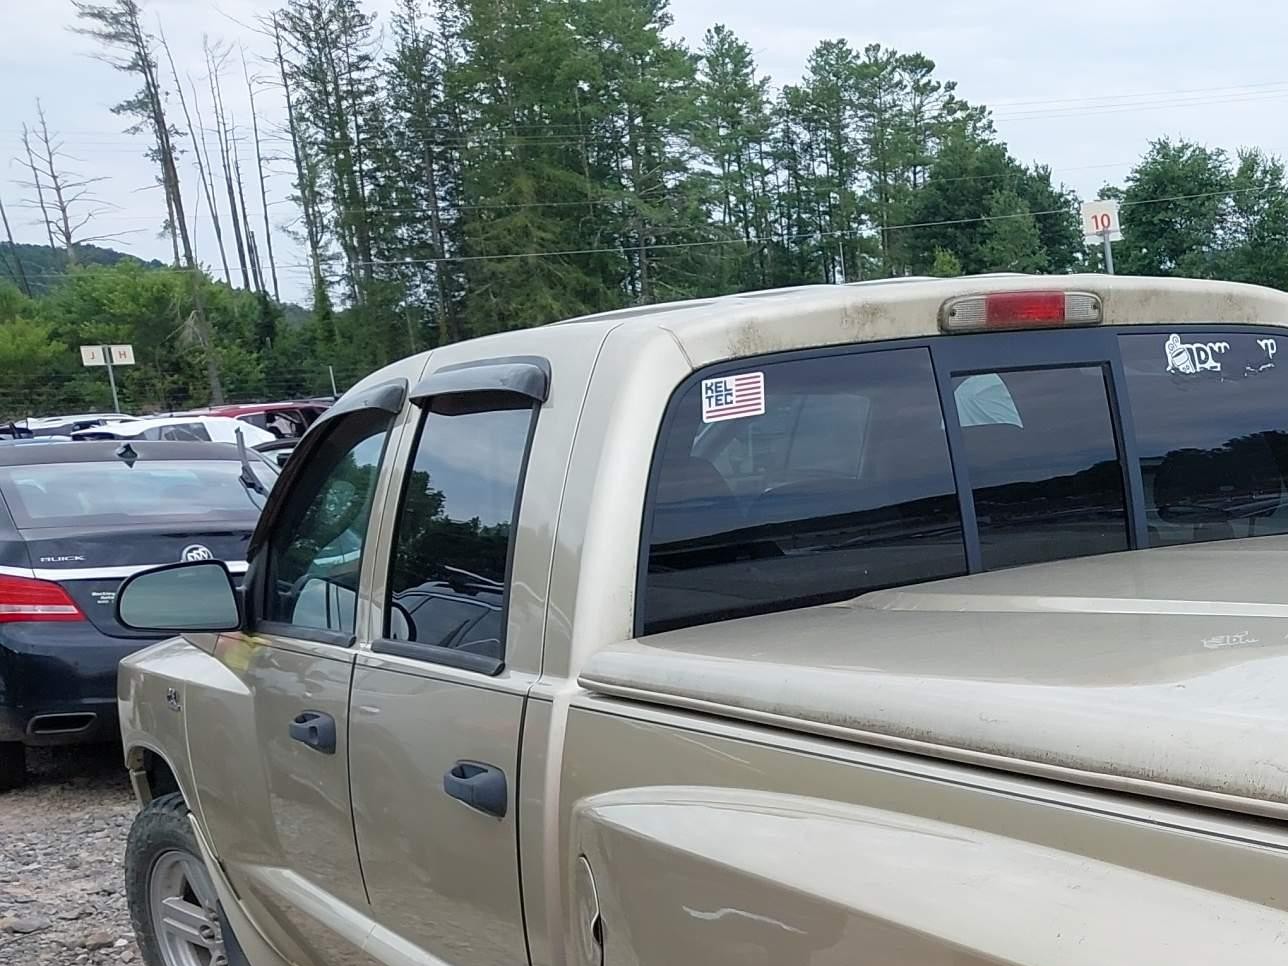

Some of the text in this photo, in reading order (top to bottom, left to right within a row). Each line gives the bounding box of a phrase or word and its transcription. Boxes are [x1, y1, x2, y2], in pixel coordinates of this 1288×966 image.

[1091, 213, 1111, 230] 10
[90, 351, 96, 360] J
[118, 350, 127, 359] H
[705, 379, 733, 395] KEL
[705, 392, 734, 408] TEC
